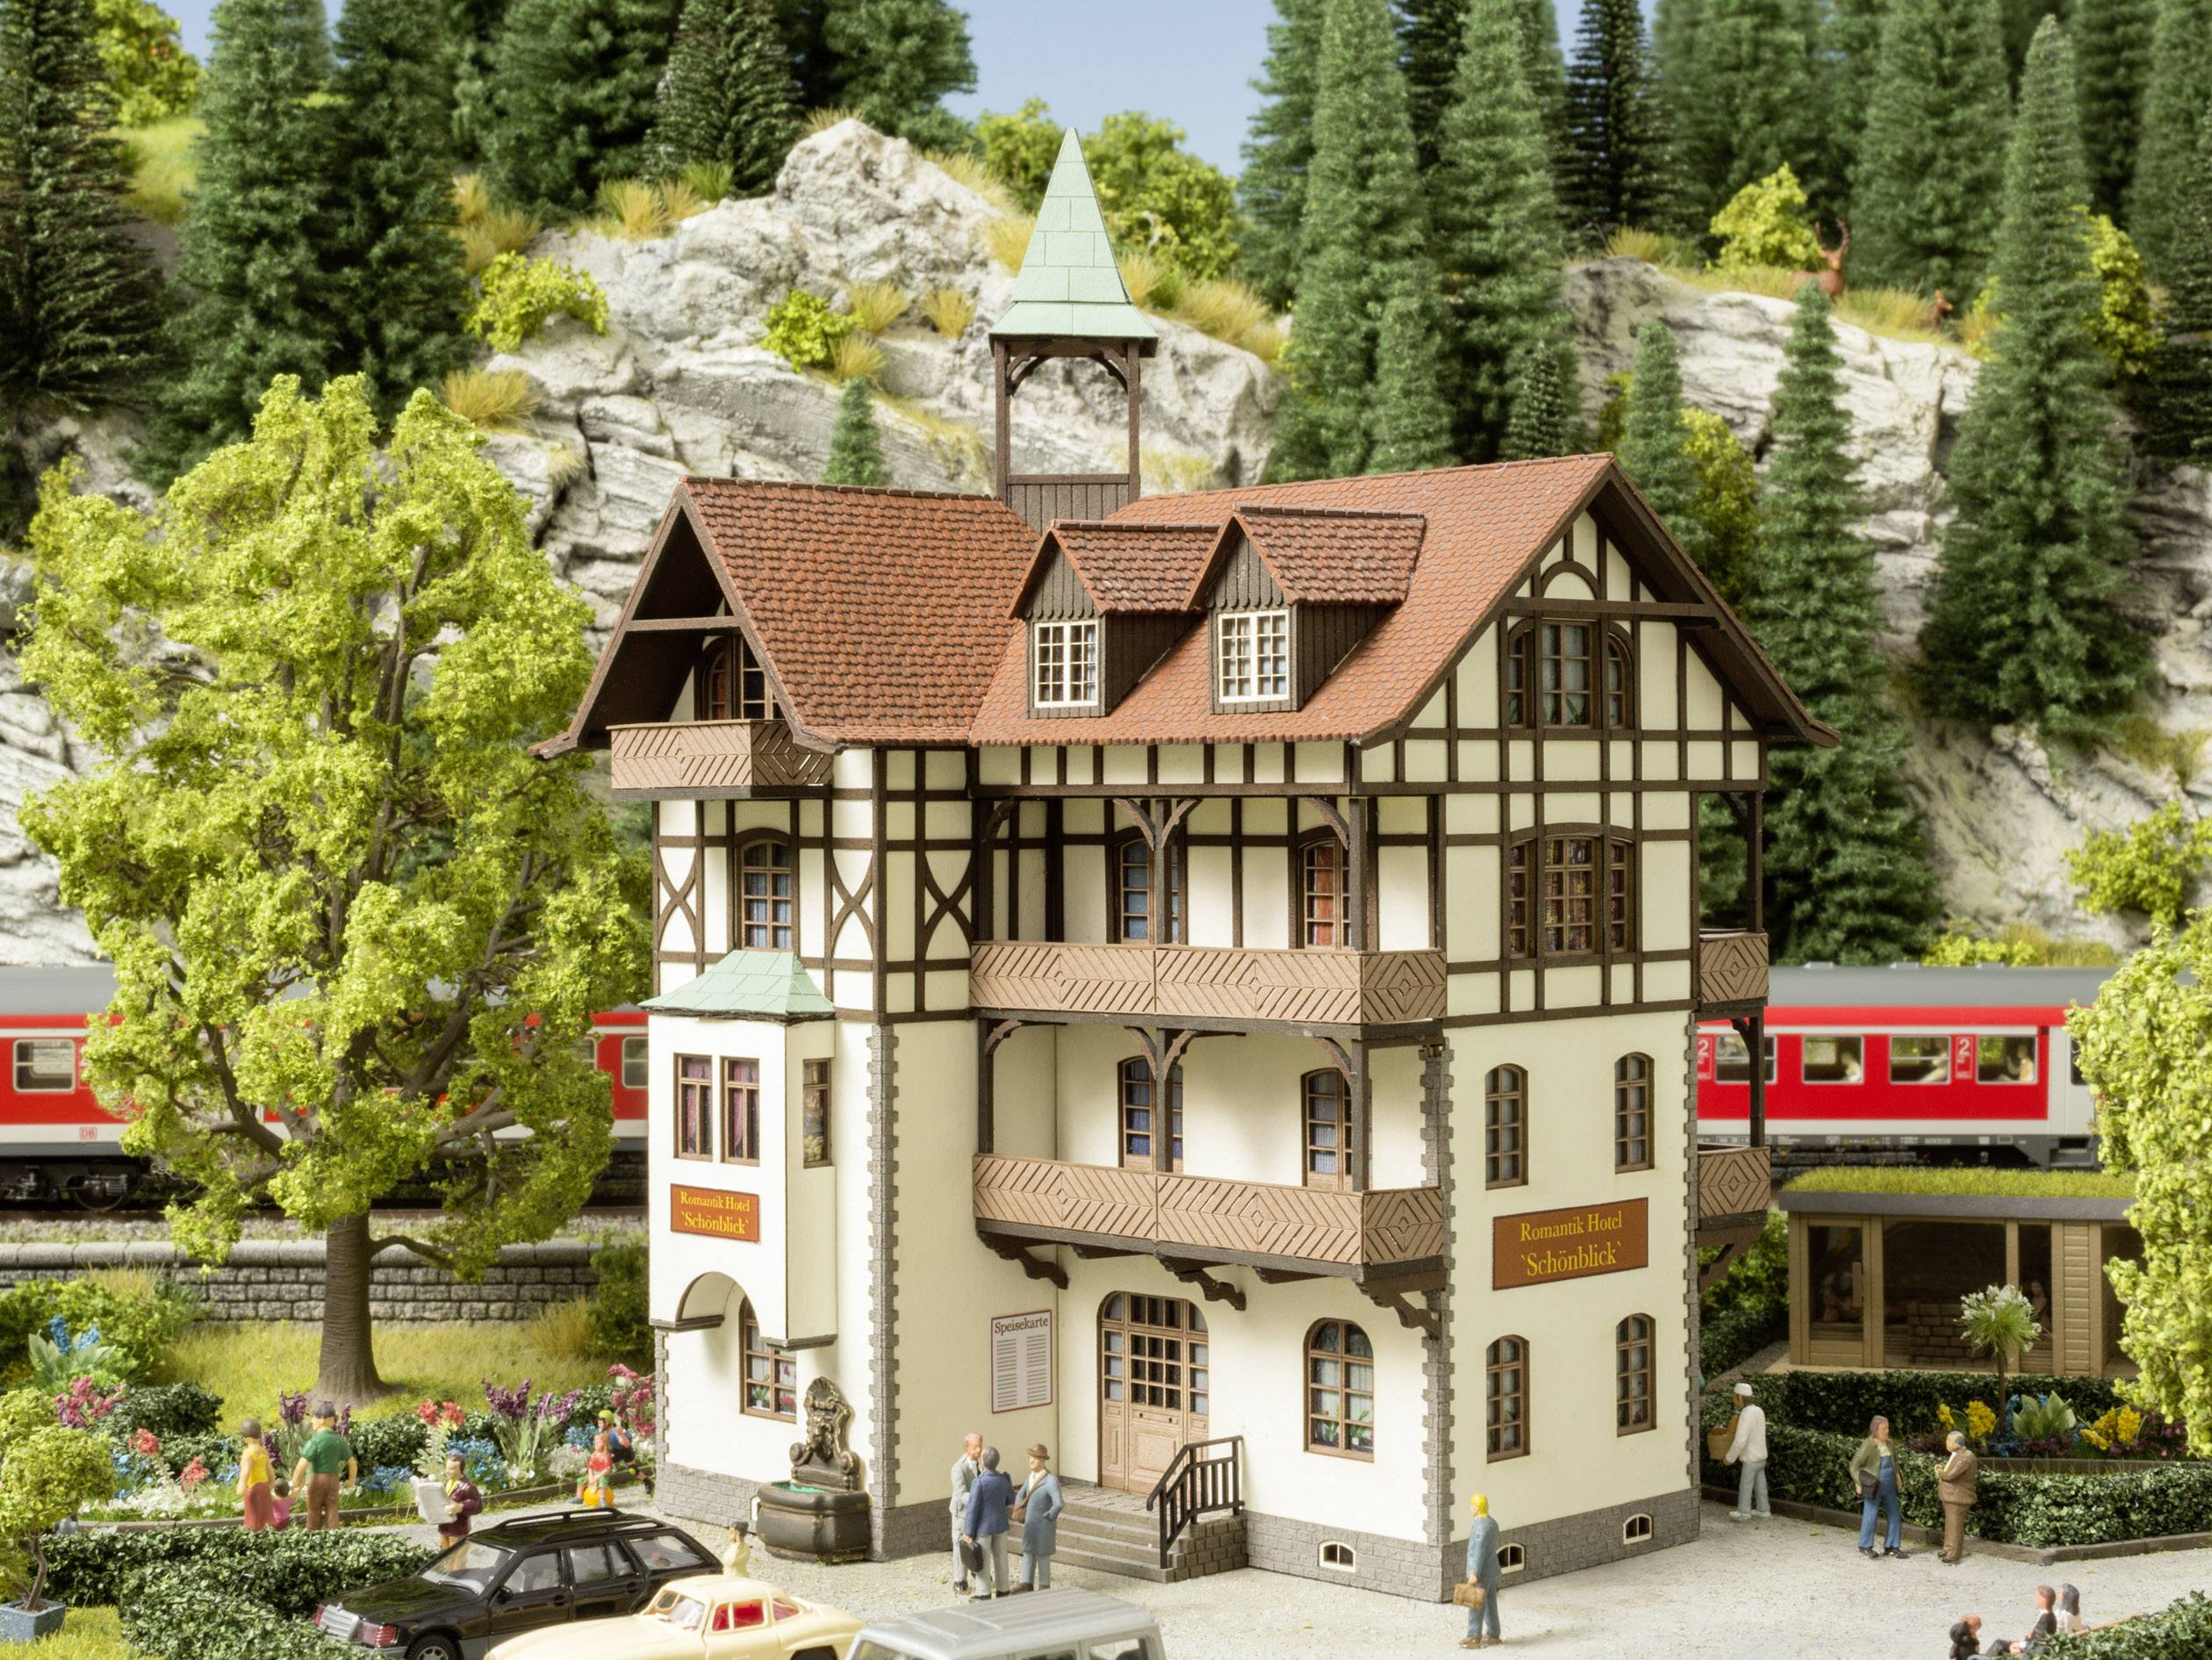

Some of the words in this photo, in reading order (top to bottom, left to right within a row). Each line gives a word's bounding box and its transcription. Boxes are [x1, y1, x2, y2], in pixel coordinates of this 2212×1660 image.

[1698, 1039, 1709, 1056] 2
[1958, 1038, 1970, 1056] 2
[680, 1190, 723, 1209] Romantik
[726, 1196, 750, 1212] Hotel
[1520, 1216, 1584, 1241] Romantik
[1587, 1211, 1622, 1232] Hotel
[995, 1318, 1049, 1336] Speisekarte
